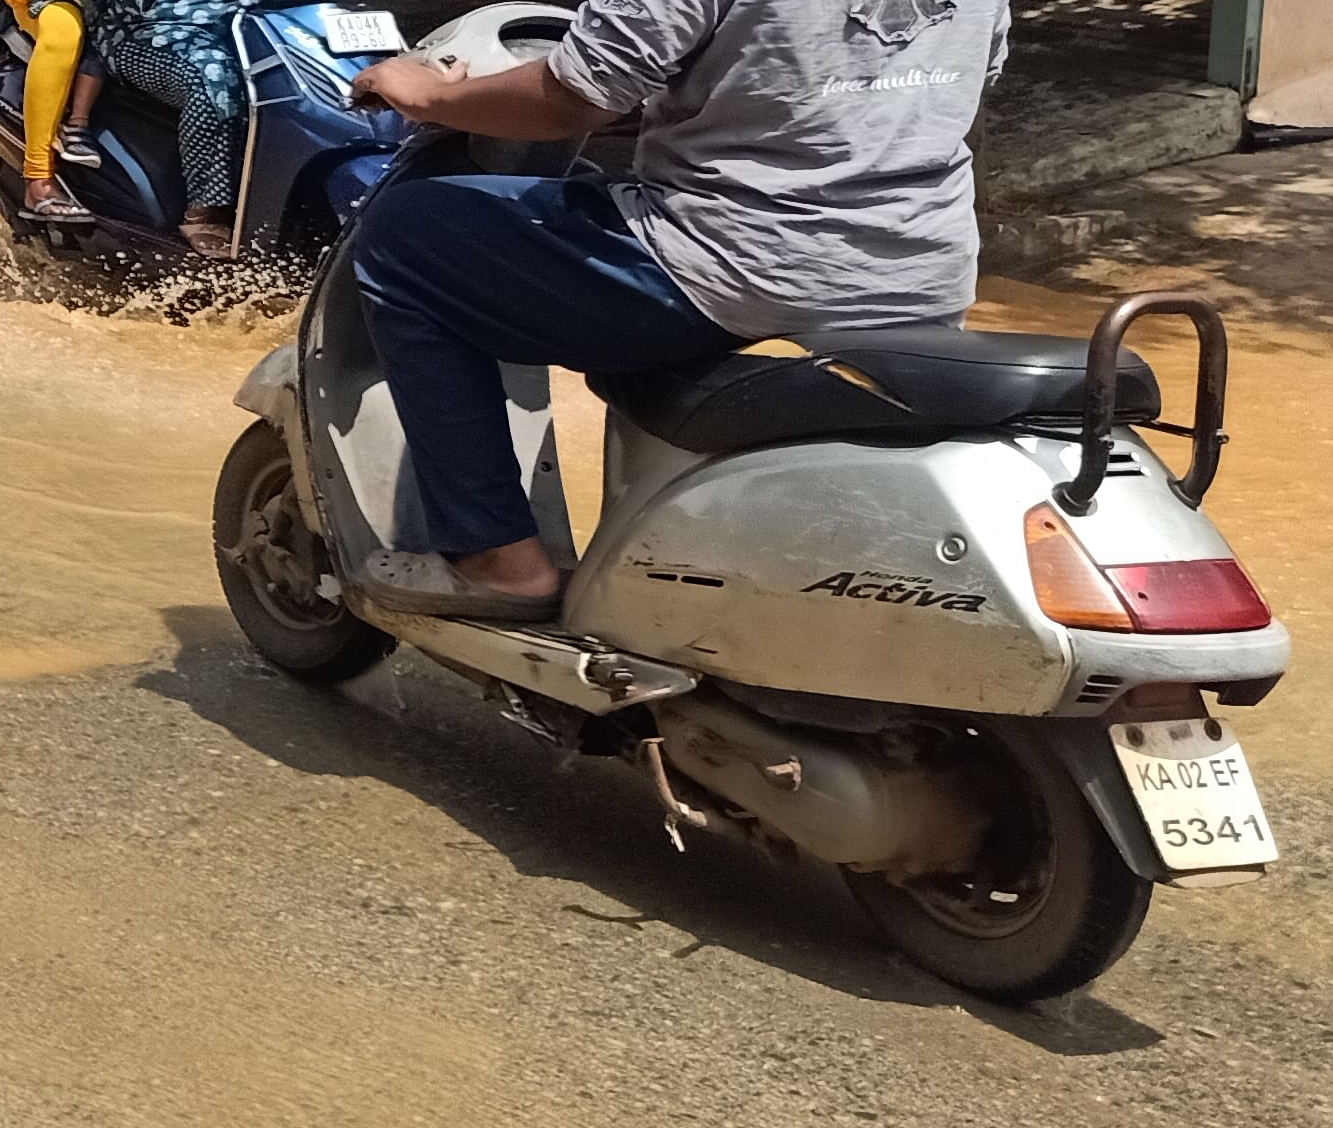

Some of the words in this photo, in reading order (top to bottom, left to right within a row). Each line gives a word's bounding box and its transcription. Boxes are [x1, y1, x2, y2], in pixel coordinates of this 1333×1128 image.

[798, 571, 988, 613] Activa
[859, 569, 934, 585] Honda
[1137, 762, 1178, 791] KA
[1177, 761, 1208, 789] 02
[1209, 758, 1240, 787] EF
[1162, 814, 1265, 848] 5341
